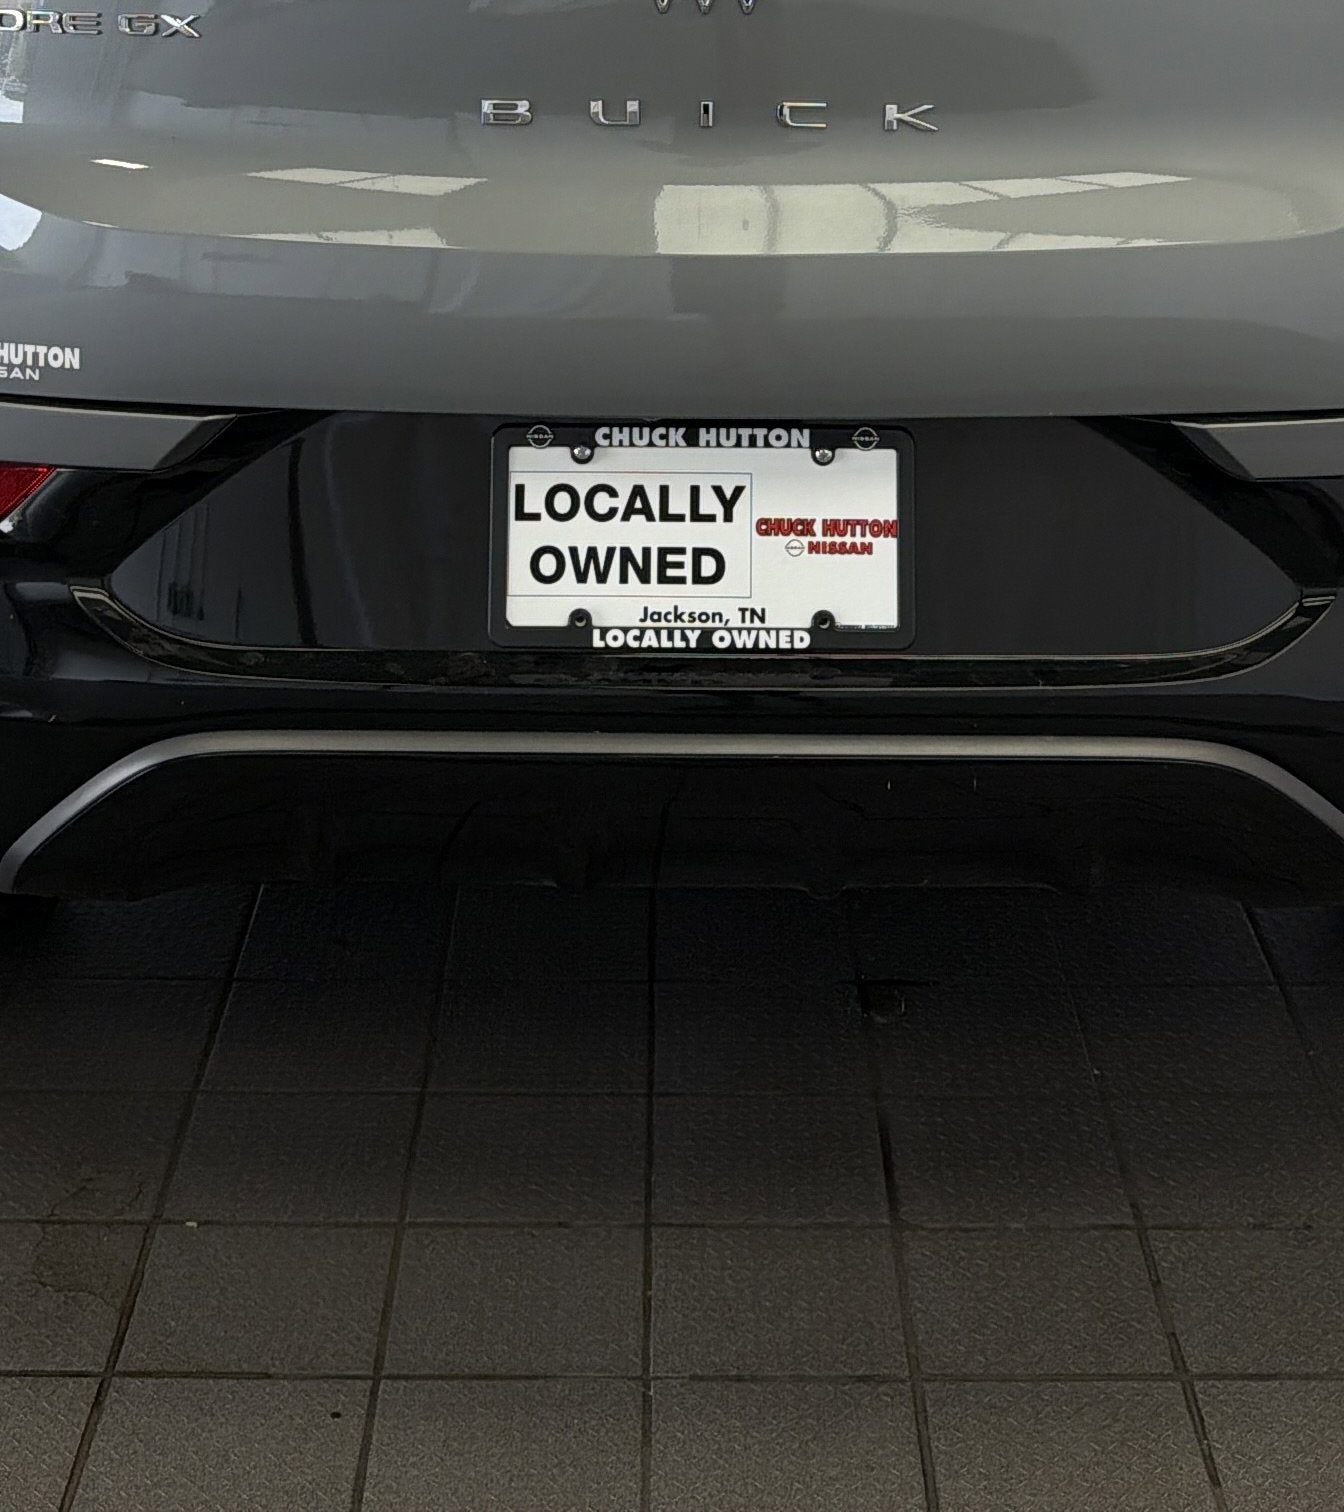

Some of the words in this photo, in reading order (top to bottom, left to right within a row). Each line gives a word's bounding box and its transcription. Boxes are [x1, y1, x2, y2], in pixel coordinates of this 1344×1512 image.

[117, 13, 202, 39] GX
[480, 98, 940, 132] BUICK
[594, 427, 687, 448] CHUCK
[698, 428, 811, 449] HUTTON
[514, 483, 746, 523] LOCALLY
[755, 517, 817, 538] CHUCK
[821, 518, 898, 539] HUTTON
[807, 540, 874, 556] NISSAN
[529, 545, 726, 585] OWNED
[638, 605, 730, 627] Jackson,
[737, 607, 766, 625] TN
[592, 628, 701, 649] LOCALLY
[712, 629, 812, 650] OWNED
